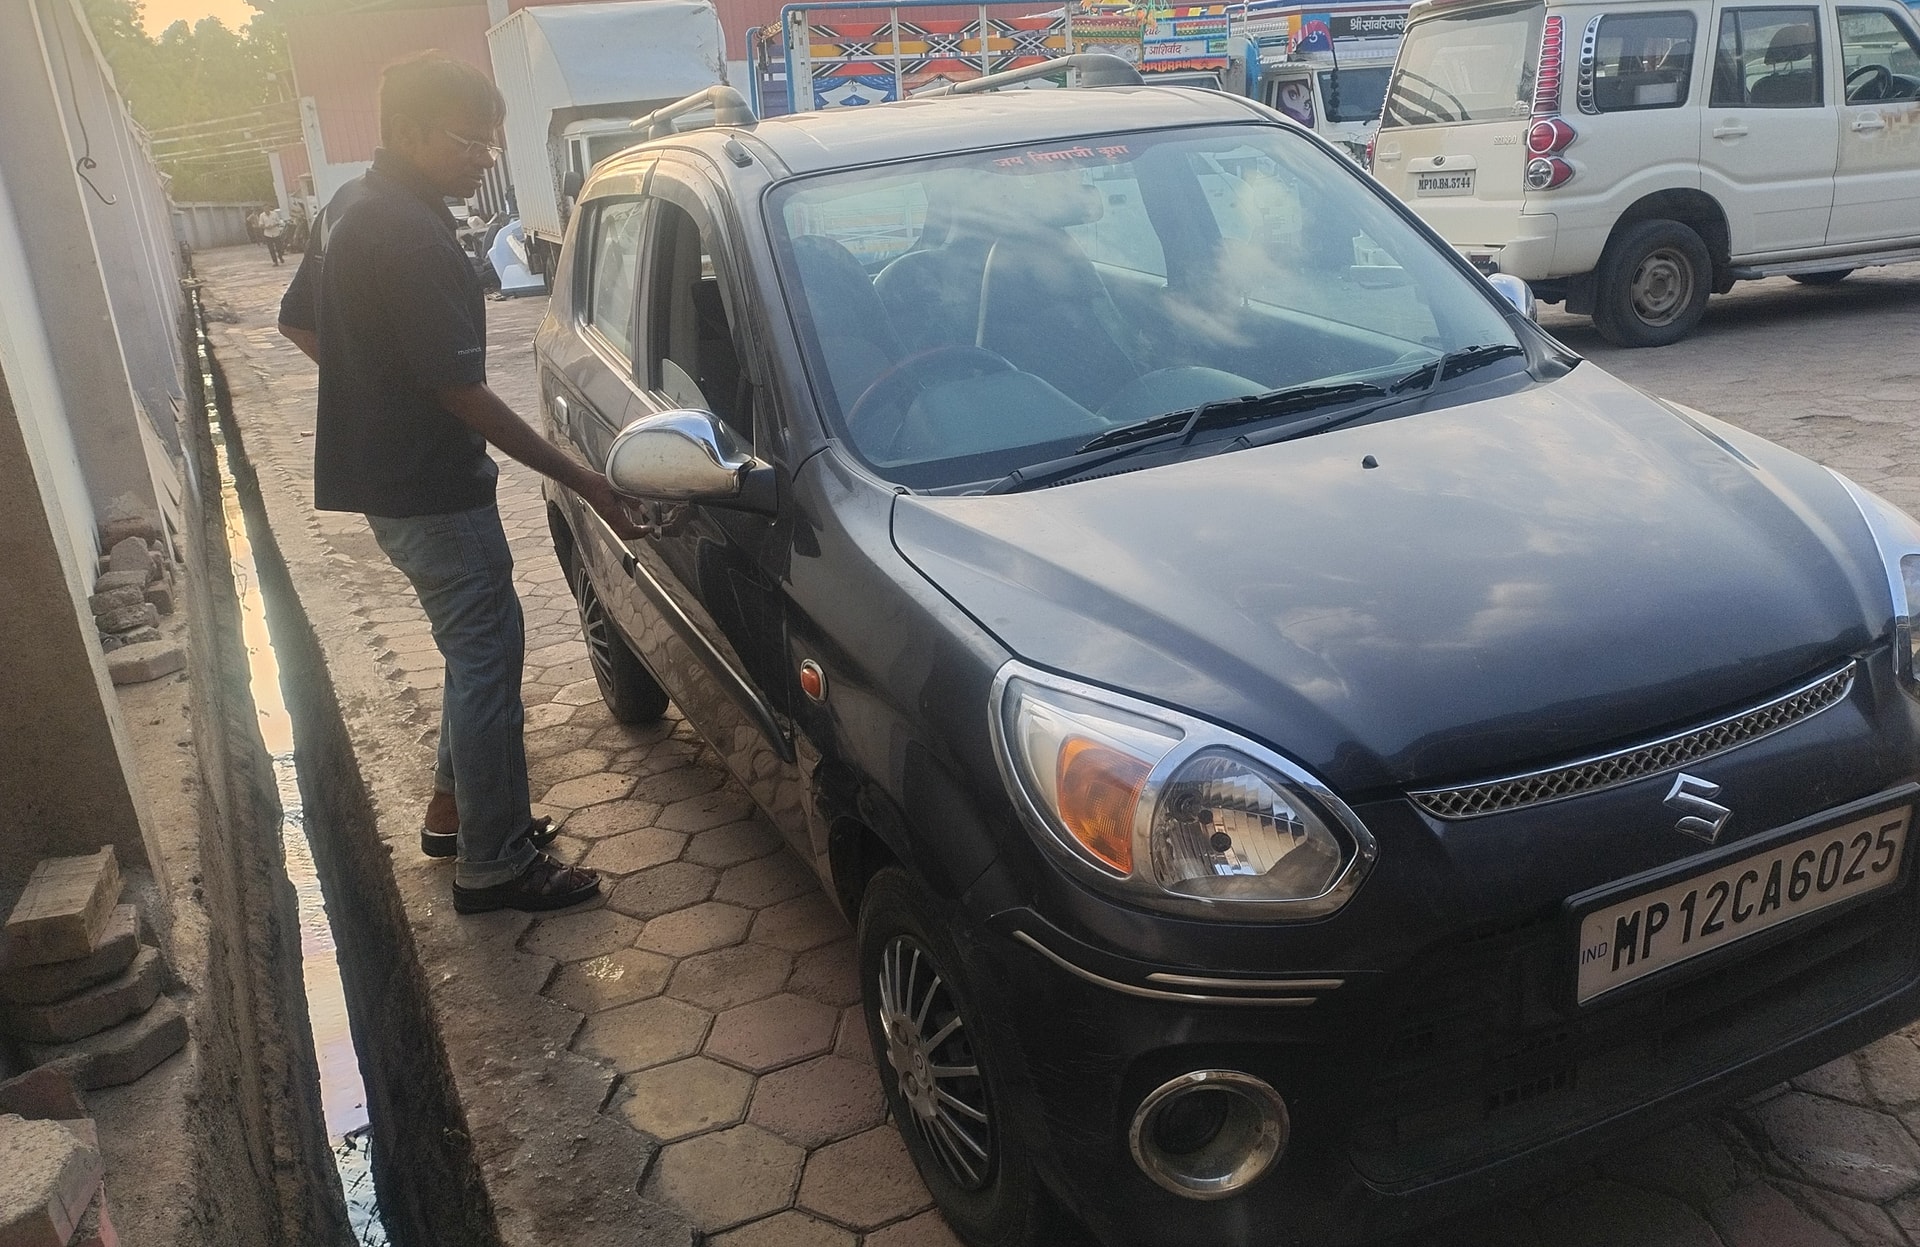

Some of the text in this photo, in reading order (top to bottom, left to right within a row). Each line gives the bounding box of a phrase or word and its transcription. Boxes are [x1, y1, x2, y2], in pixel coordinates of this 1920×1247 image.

[992, 156, 1024, 167] जय
[1611, 820, 1903, 972] MP12CA6025
[1581, 942, 1608, 965] IND
